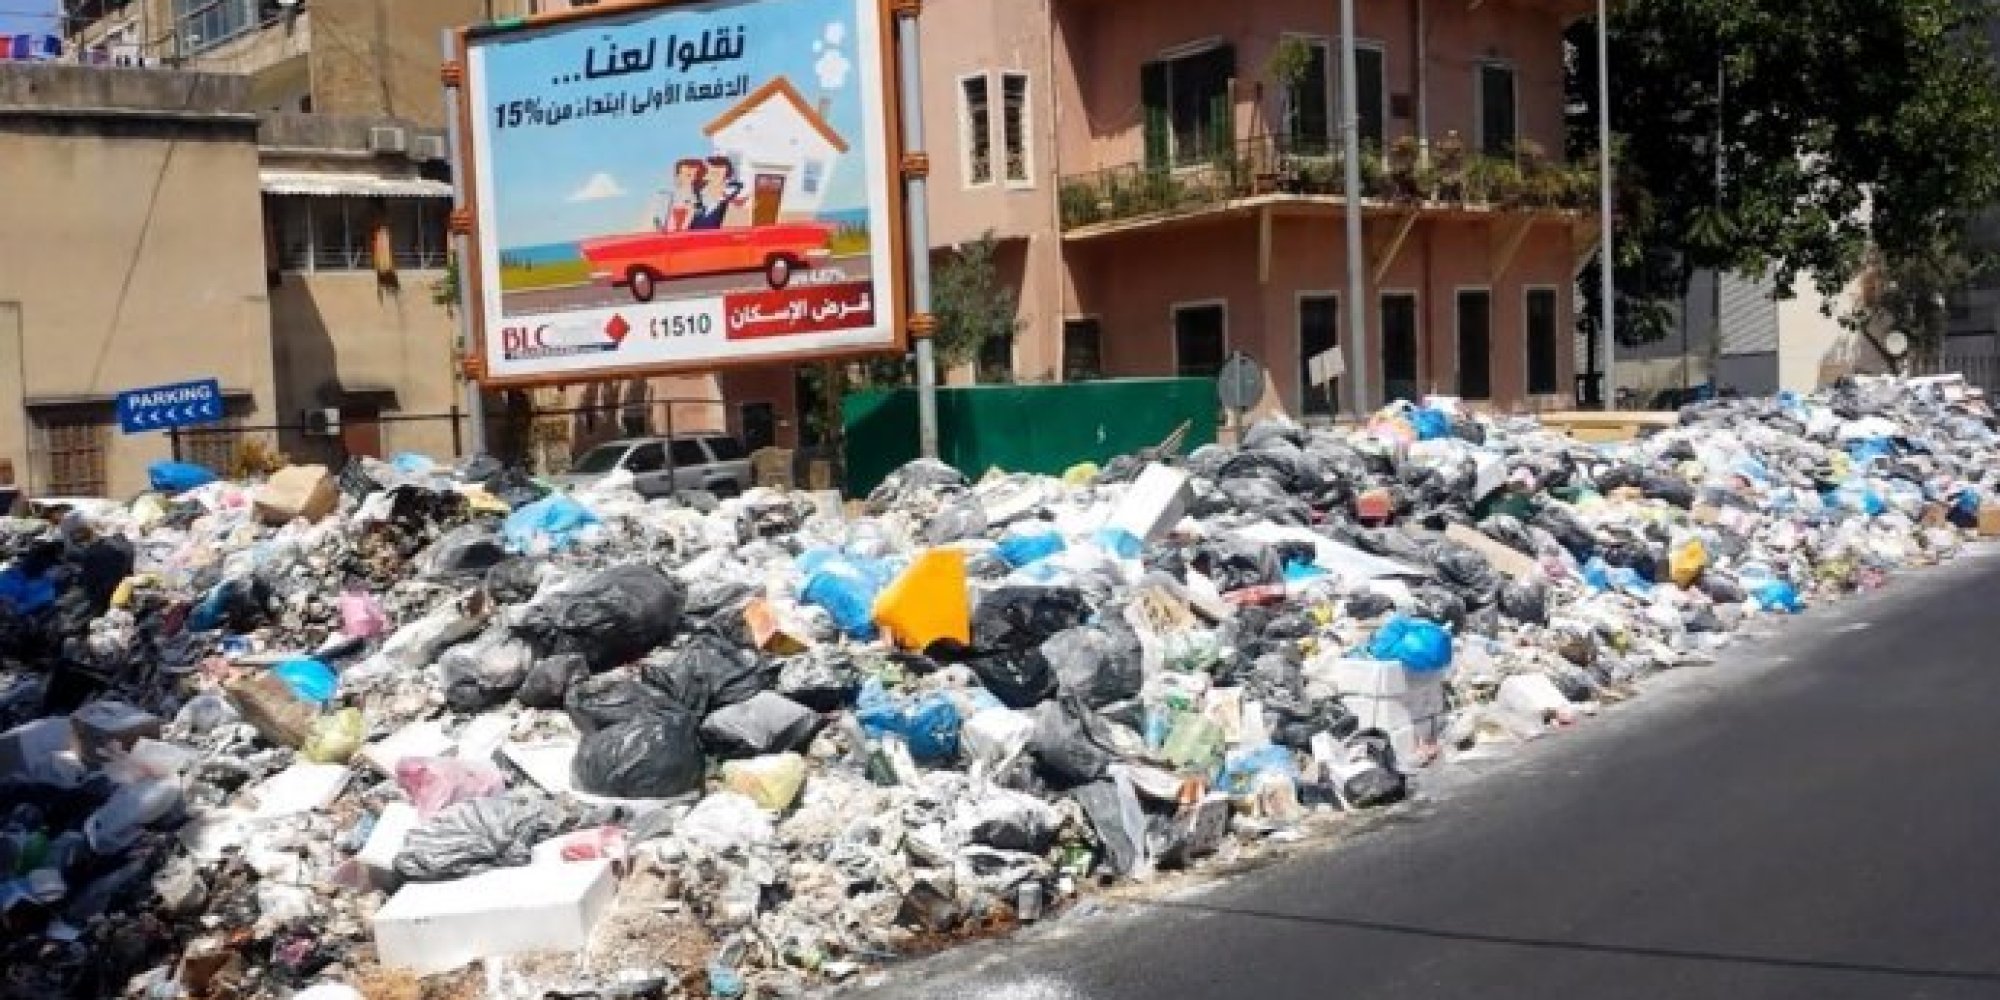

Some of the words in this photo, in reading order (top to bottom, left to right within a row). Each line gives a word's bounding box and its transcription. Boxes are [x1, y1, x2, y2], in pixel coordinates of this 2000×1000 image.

[666, 25, 745, 72] نقلوا
[684, 74, 748, 101] الدفعة
[494, 96, 543, 129] 15%
[545, 100, 573, 126] من
[812, 292, 870, 321] قرض
[661, 312, 712, 337] 1510
[128, 385, 212, 410] PARKING
